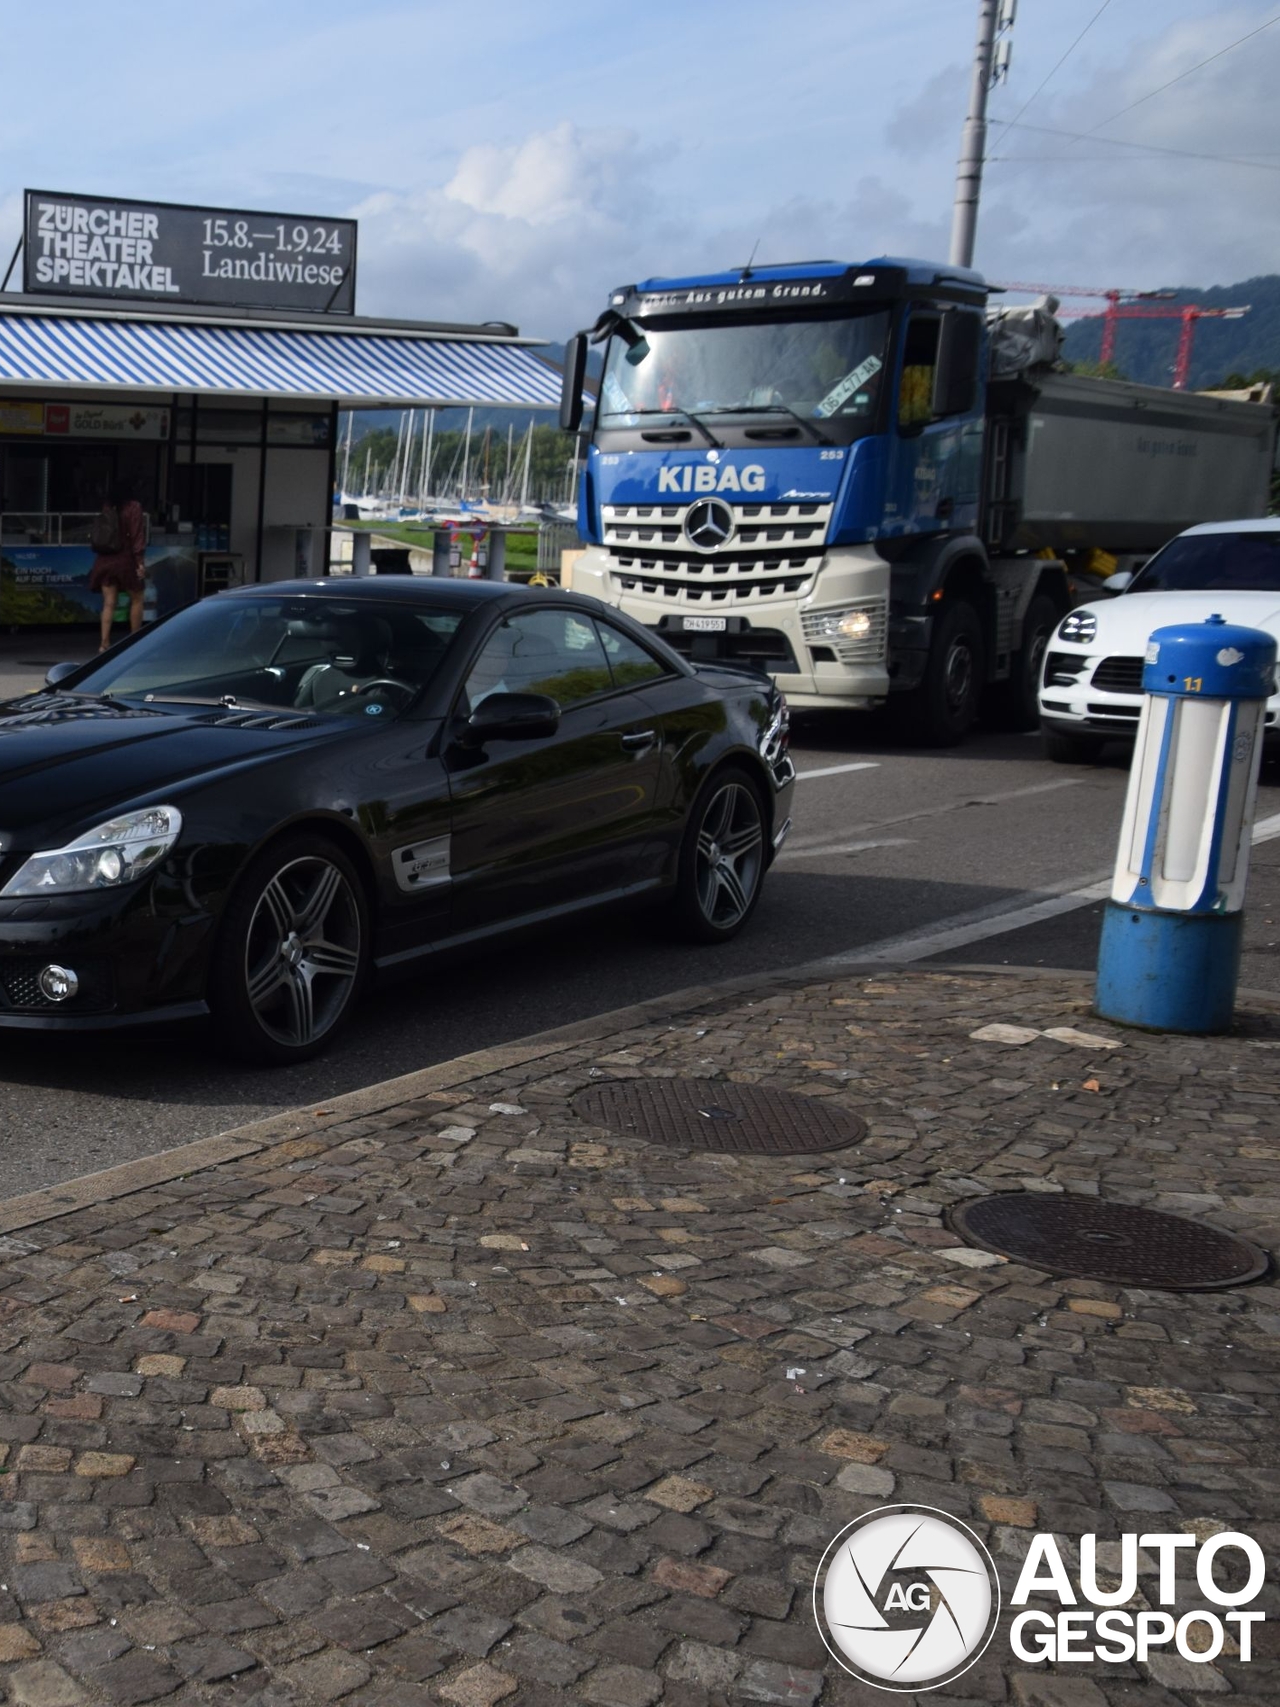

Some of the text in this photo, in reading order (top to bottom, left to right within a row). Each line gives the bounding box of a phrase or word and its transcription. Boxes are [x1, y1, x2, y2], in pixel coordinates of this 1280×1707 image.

[37, 203, 159, 239] ZÜRCHER
[37, 231, 154, 265] THEATER
[35, 256, 181, 292] SPEKTAKEL
[201, 250, 344, 286] Landiwiese
[685, 291, 711, 304] Aus
[717, 286, 766, 304] gutem
[773, 283, 827, 299] Grund.
[820, 450, 845, 460] 253
[658, 464, 766, 492] KIBAG
[29, 566, 52, 575] HOCH
[31, 575, 44, 583] DIE
